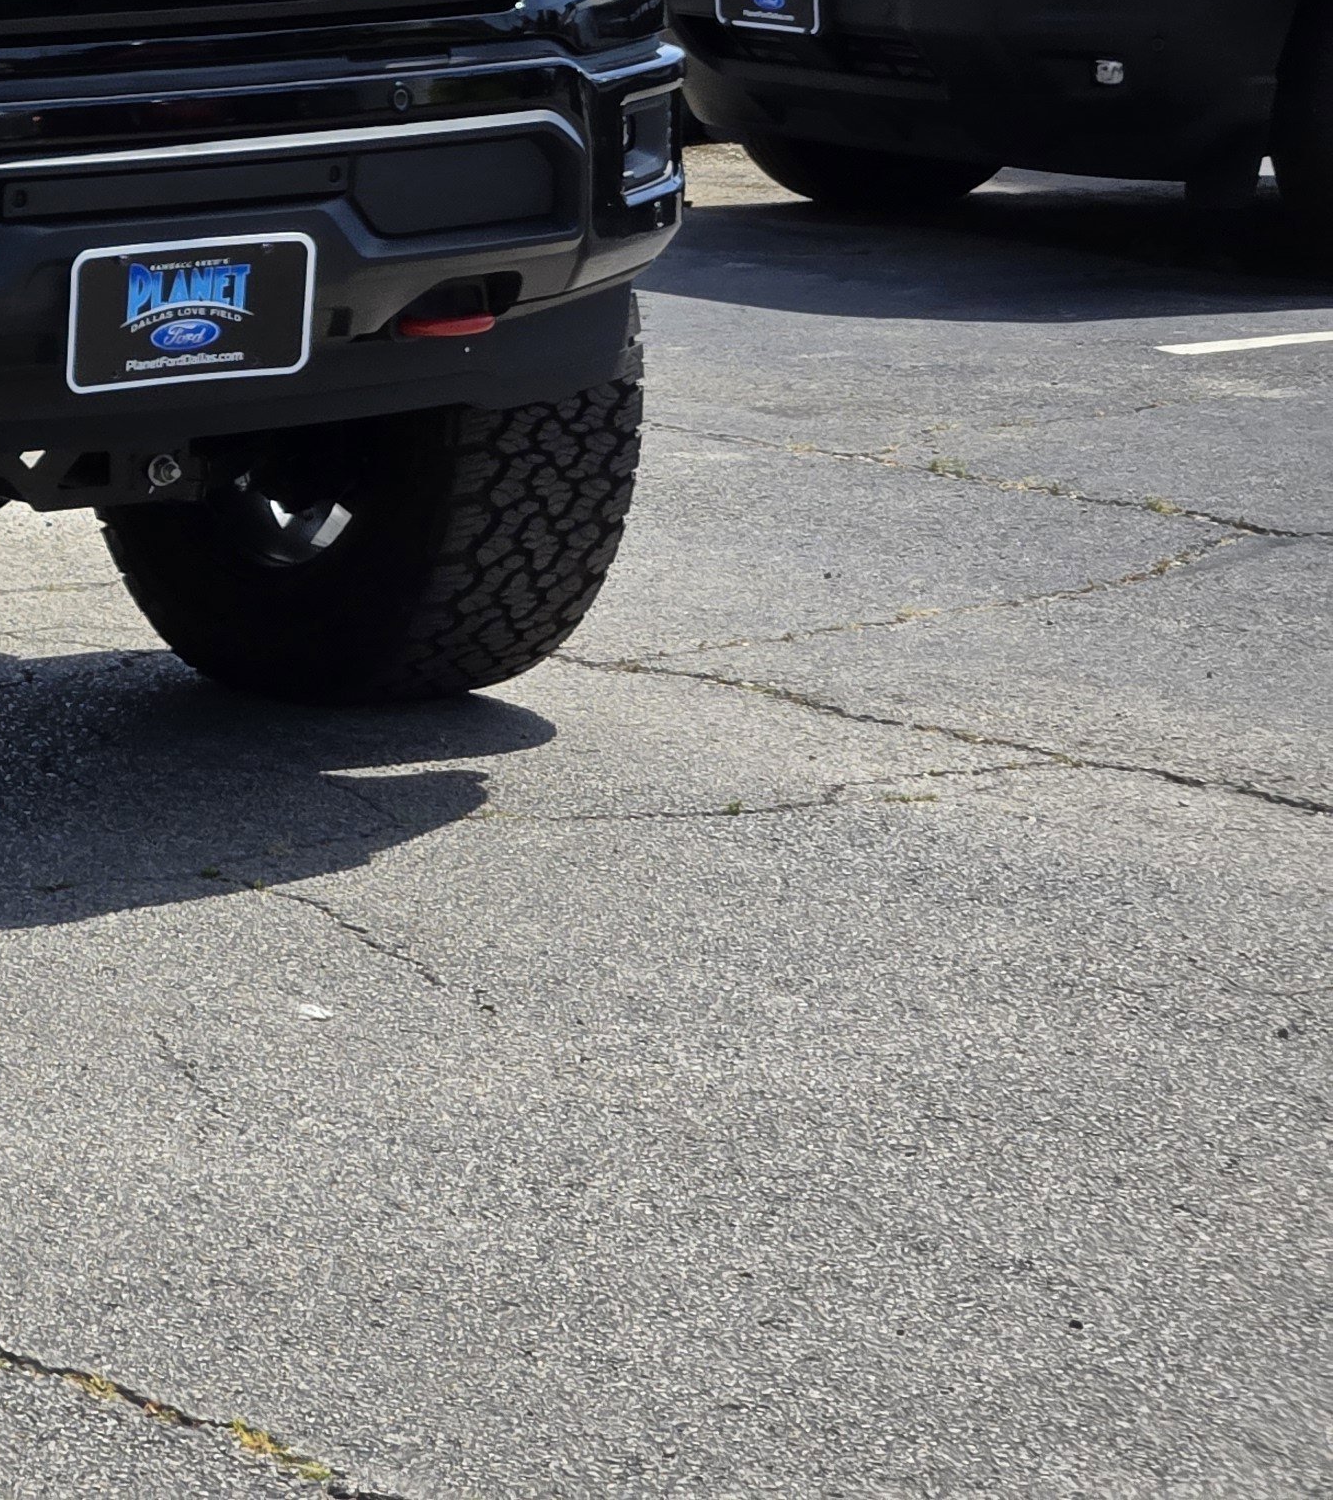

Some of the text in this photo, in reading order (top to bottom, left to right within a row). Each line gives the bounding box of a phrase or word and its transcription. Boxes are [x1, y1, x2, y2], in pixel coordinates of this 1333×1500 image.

[127, 263, 252, 323] PLANET
[130, 307, 244, 334] DALLAS LOVE FIELD
[163, 324, 206, 346] Ford
